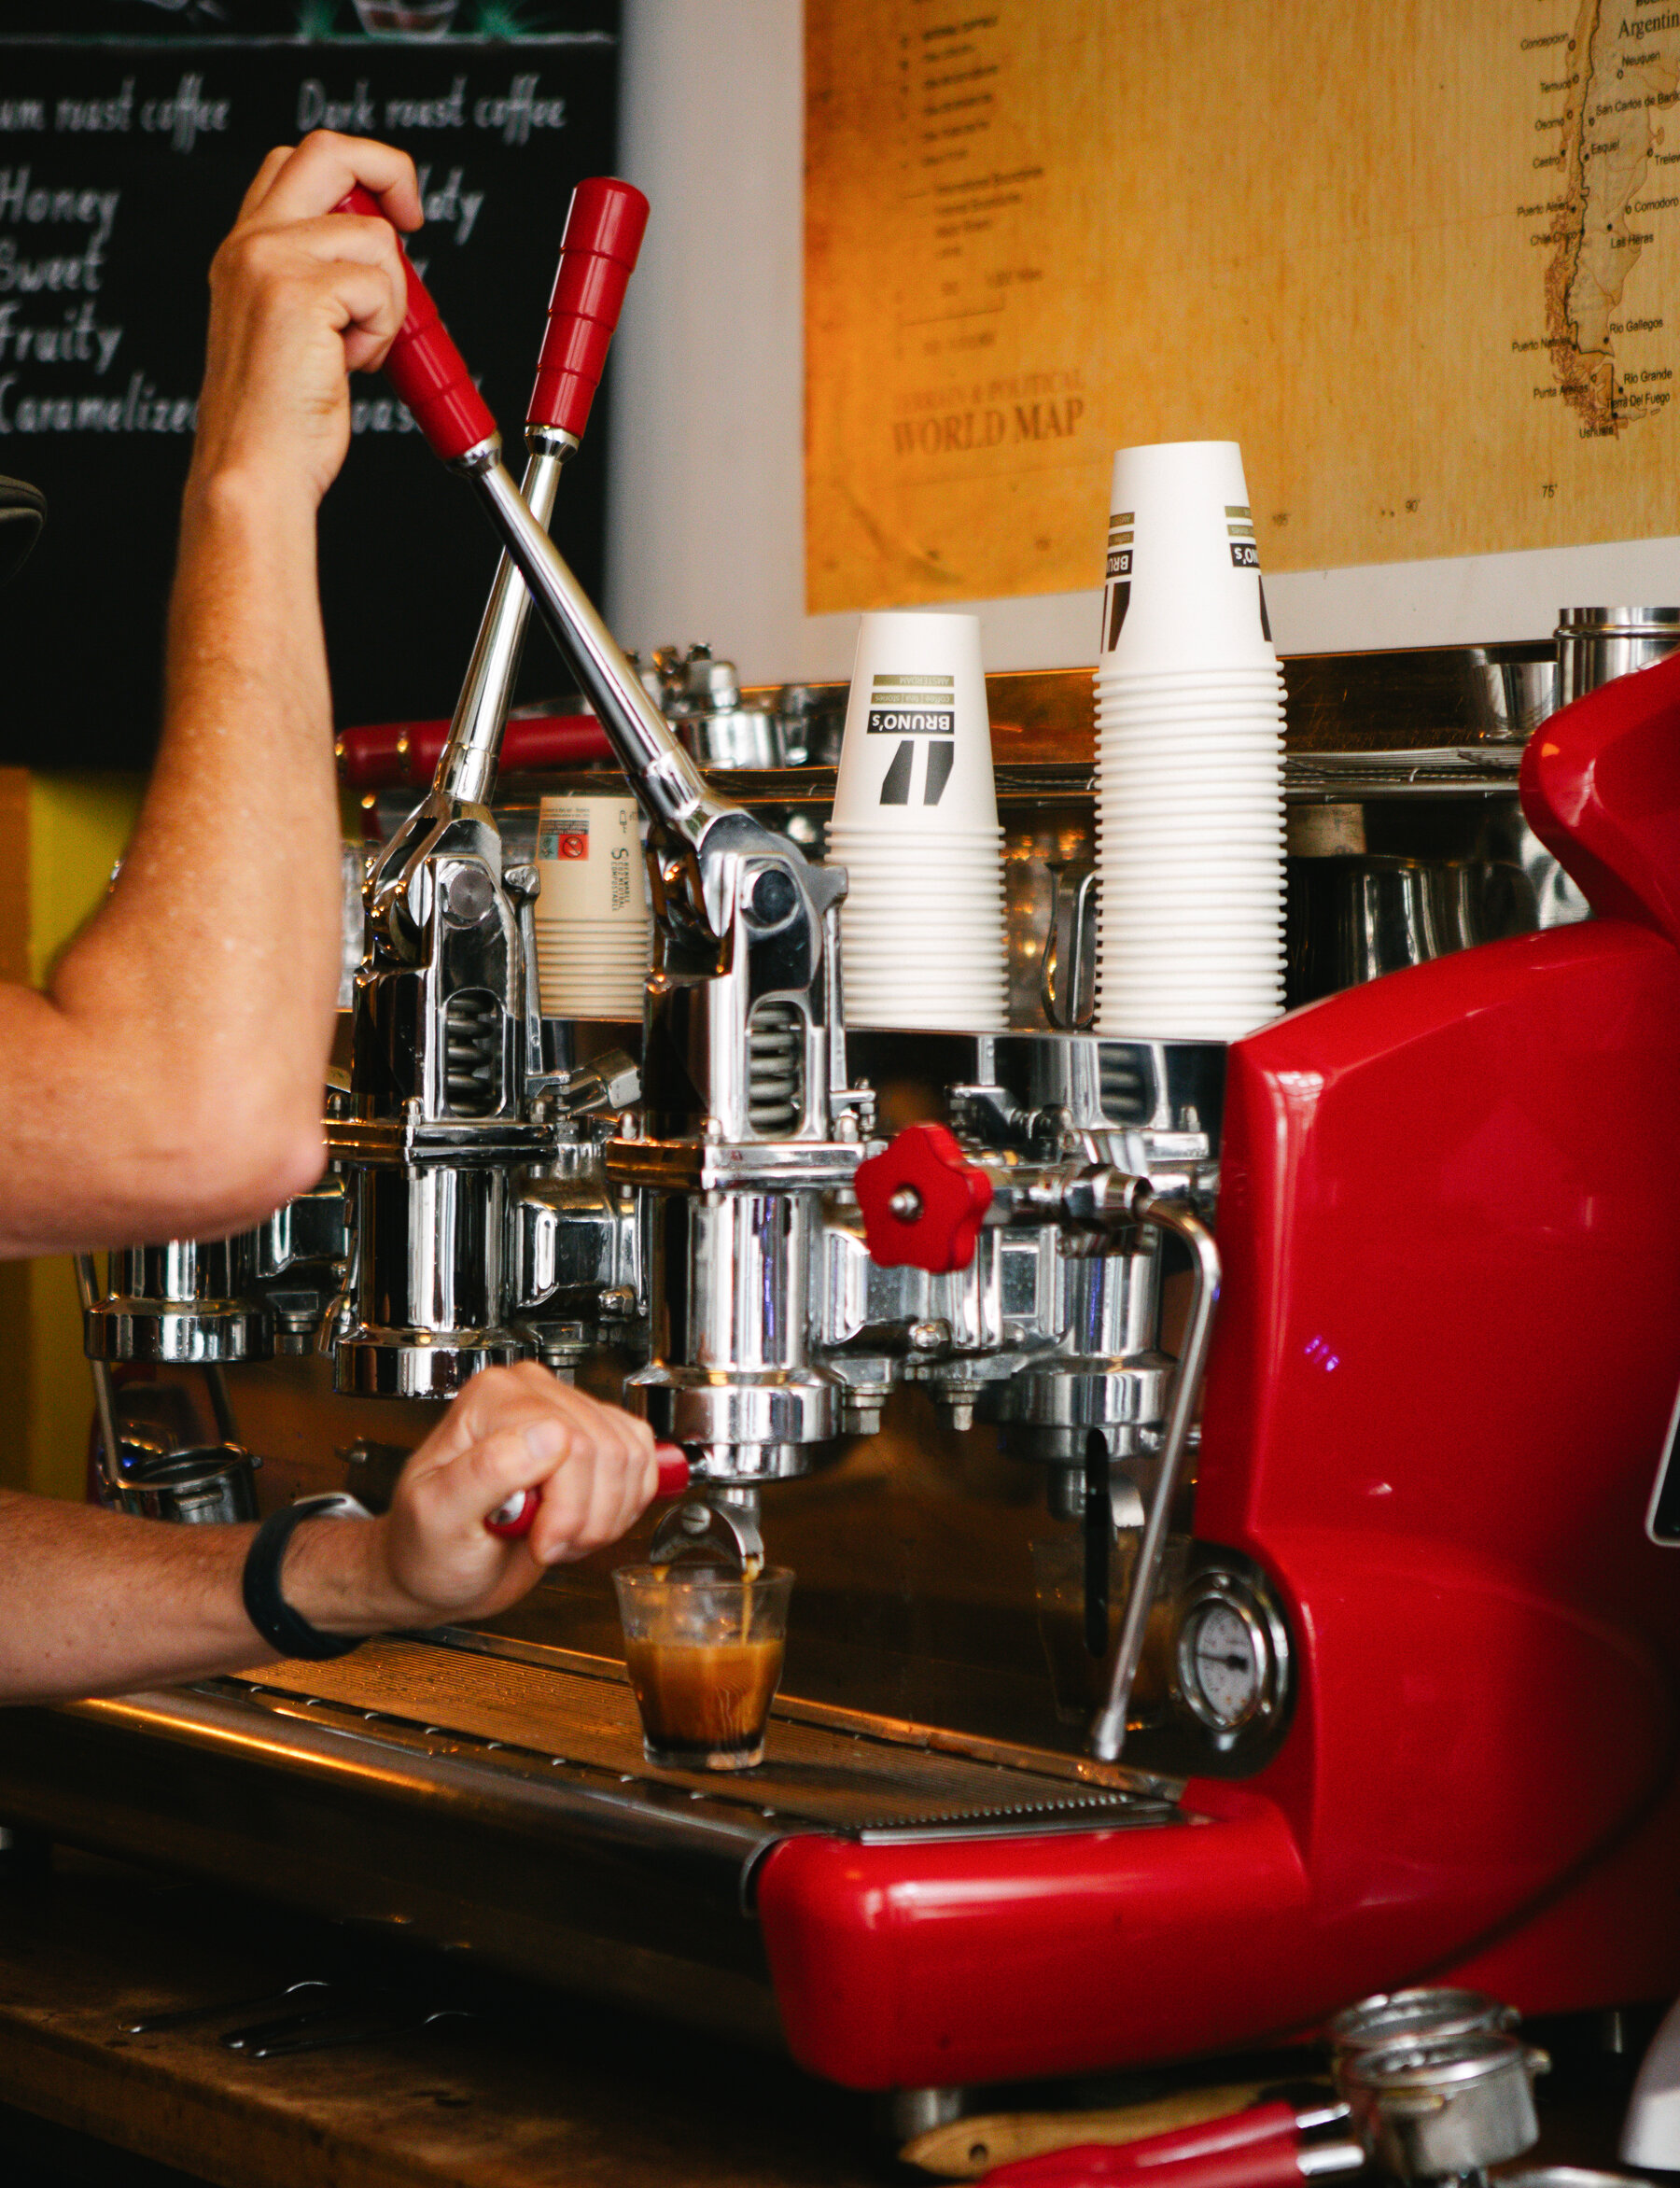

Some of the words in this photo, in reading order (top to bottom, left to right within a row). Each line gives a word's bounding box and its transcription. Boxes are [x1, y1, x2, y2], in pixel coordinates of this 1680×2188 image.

[141, 73, 231, 155] coffee
[297, 77, 374, 131] Dark
[385, 75, 467, 130] roast
[474, 73, 566, 147] coffee
[0, 165, 121, 245] Honey
[1634, 197, 1679, 213] Comodoro
[1611, 236, 1626, 248] Las
[0, 236, 105, 292] Sweet
[1626, 318, 1663, 332] Gallegos
[0, 300, 122, 374] Fruity
[1512, 341, 1539, 352] Puerto
[1641, 368, 1673, 383] Grande
[1533, 386, 1557, 400] Punta
[1630, 393, 1644, 407] Del
[1645, 392, 1671, 406] Fuego
[893, 409, 1007, 456] WORLD
[1014, 397, 1085, 444] MAP
